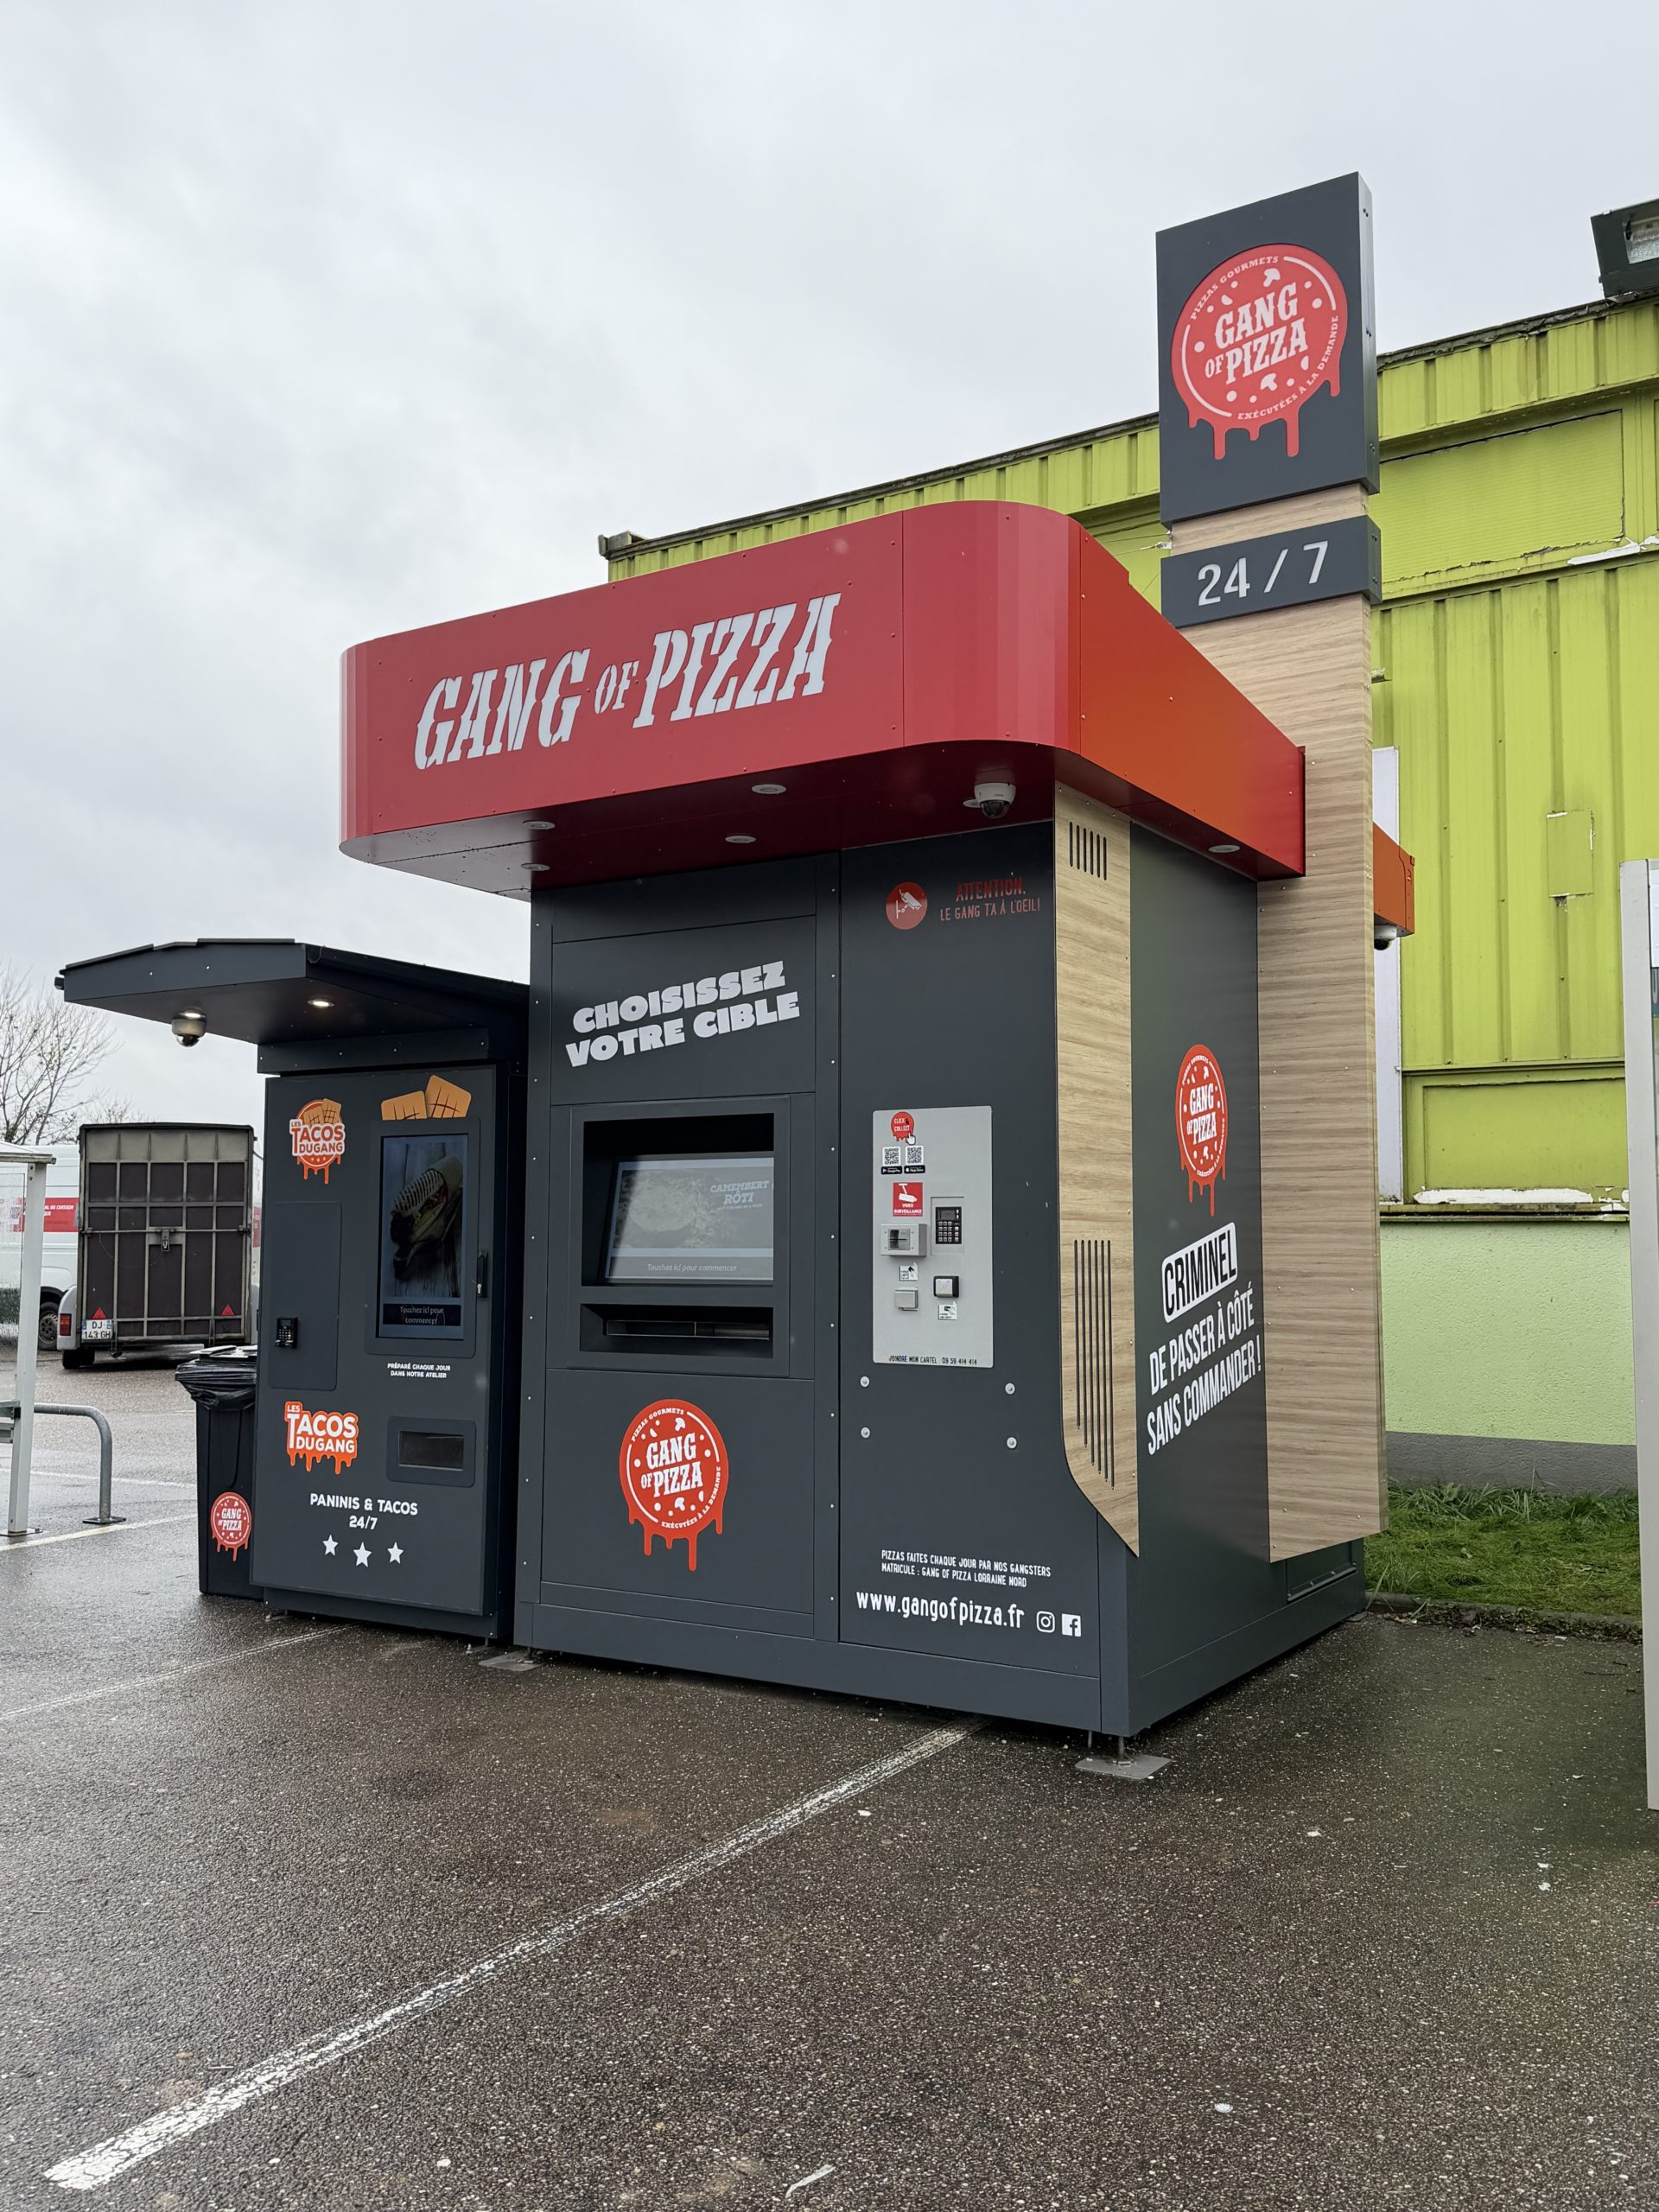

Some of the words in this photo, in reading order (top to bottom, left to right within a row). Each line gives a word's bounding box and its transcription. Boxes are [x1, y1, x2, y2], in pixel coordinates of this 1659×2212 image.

[1190, 283, 1218, 321] PIZZAS
[1219, 256, 1279, 283] GOURMETS
[1215, 282, 1298, 350] GANG
[1205, 353, 1224, 378] OF
[1225, 317, 1308, 385] PIZZA
[1306, 372, 1319, 387] LA
[1317, 315, 1339, 372] DEMANDE
[414, 648, 591, 770] GANG
[594, 659, 639, 715] OF
[632, 592, 842, 729] PIZZA
[940, 908, 951, 921] LE
[955, 905, 981, 920] GANG
[1000, 899, 1007, 915] À
[572, 960, 786, 1034] CHOISISSEZ
[565, 1017, 685, 1068] VOTRE
[692, 991, 800, 1039] CIBLE
[1189, 1083, 1214, 1116] GANG
[291, 1126, 344, 1154] TACOS
[1186, 1120, 1193, 1135] OF
[1192, 1111, 1217, 1146] PIZZA
[710, 1180, 769, 1192] CAMEMBERT
[723, 1191, 754, 1205] RÔTI
[1165, 1230, 1236, 1317] CRIMINEL
[1149, 1344, 1168, 1395] DE
[1169, 1313, 1216, 1382] PASSER
[1217, 1301, 1226, 1348] À
[1227, 1281, 1255, 1340] CÔTÉ
[1147, 1393, 1182, 1455] SANS
[1183, 1339, 1255, 1427] COMMANDER
[287, 1413, 356, 1448] TACOS
[632, 1418, 648, 1442] PIZZAS
[649, 1408, 684, 1420] GOURMETS
[646, 1433, 696, 1470] GANG
[641, 1473, 652, 1490] OF
[653, 1461, 703, 1497] PIZZA
[221, 1508, 242, 1519] GANG
[310, 1493, 359, 1510] PANINIS
[364, 1498, 372, 1511] &
[378, 1499, 418, 1515] TACOS
[222, 1519, 242, 1530] PIZZA
[349, 1516, 378, 1529] 24/7
[881, 1549, 905, 1560] PIZZAS
[906, 1552, 928, 1563] FAITES
[930, 1554, 957, 1567] CHAQUE
[958, 1557, 976, 1569] JOUR
[978, 1560, 992, 1571] PAR
[994, 1562, 1007, 1573] NOS
[1009, 1563, 1052, 1577] GANGSTERS
[881, 1562, 915, 1575] MATRICULE
[921, 1568, 940, 1578] GANG
[942, 1570, 950, 1579] OF
[951, 1570, 972, 1581] PIZZA
[974, 1573, 1007, 1586] LORRAINE
[1008, 1576, 1027, 1587] NORD
[855, 1592, 1026, 1628] www.gangofpizza.fr
